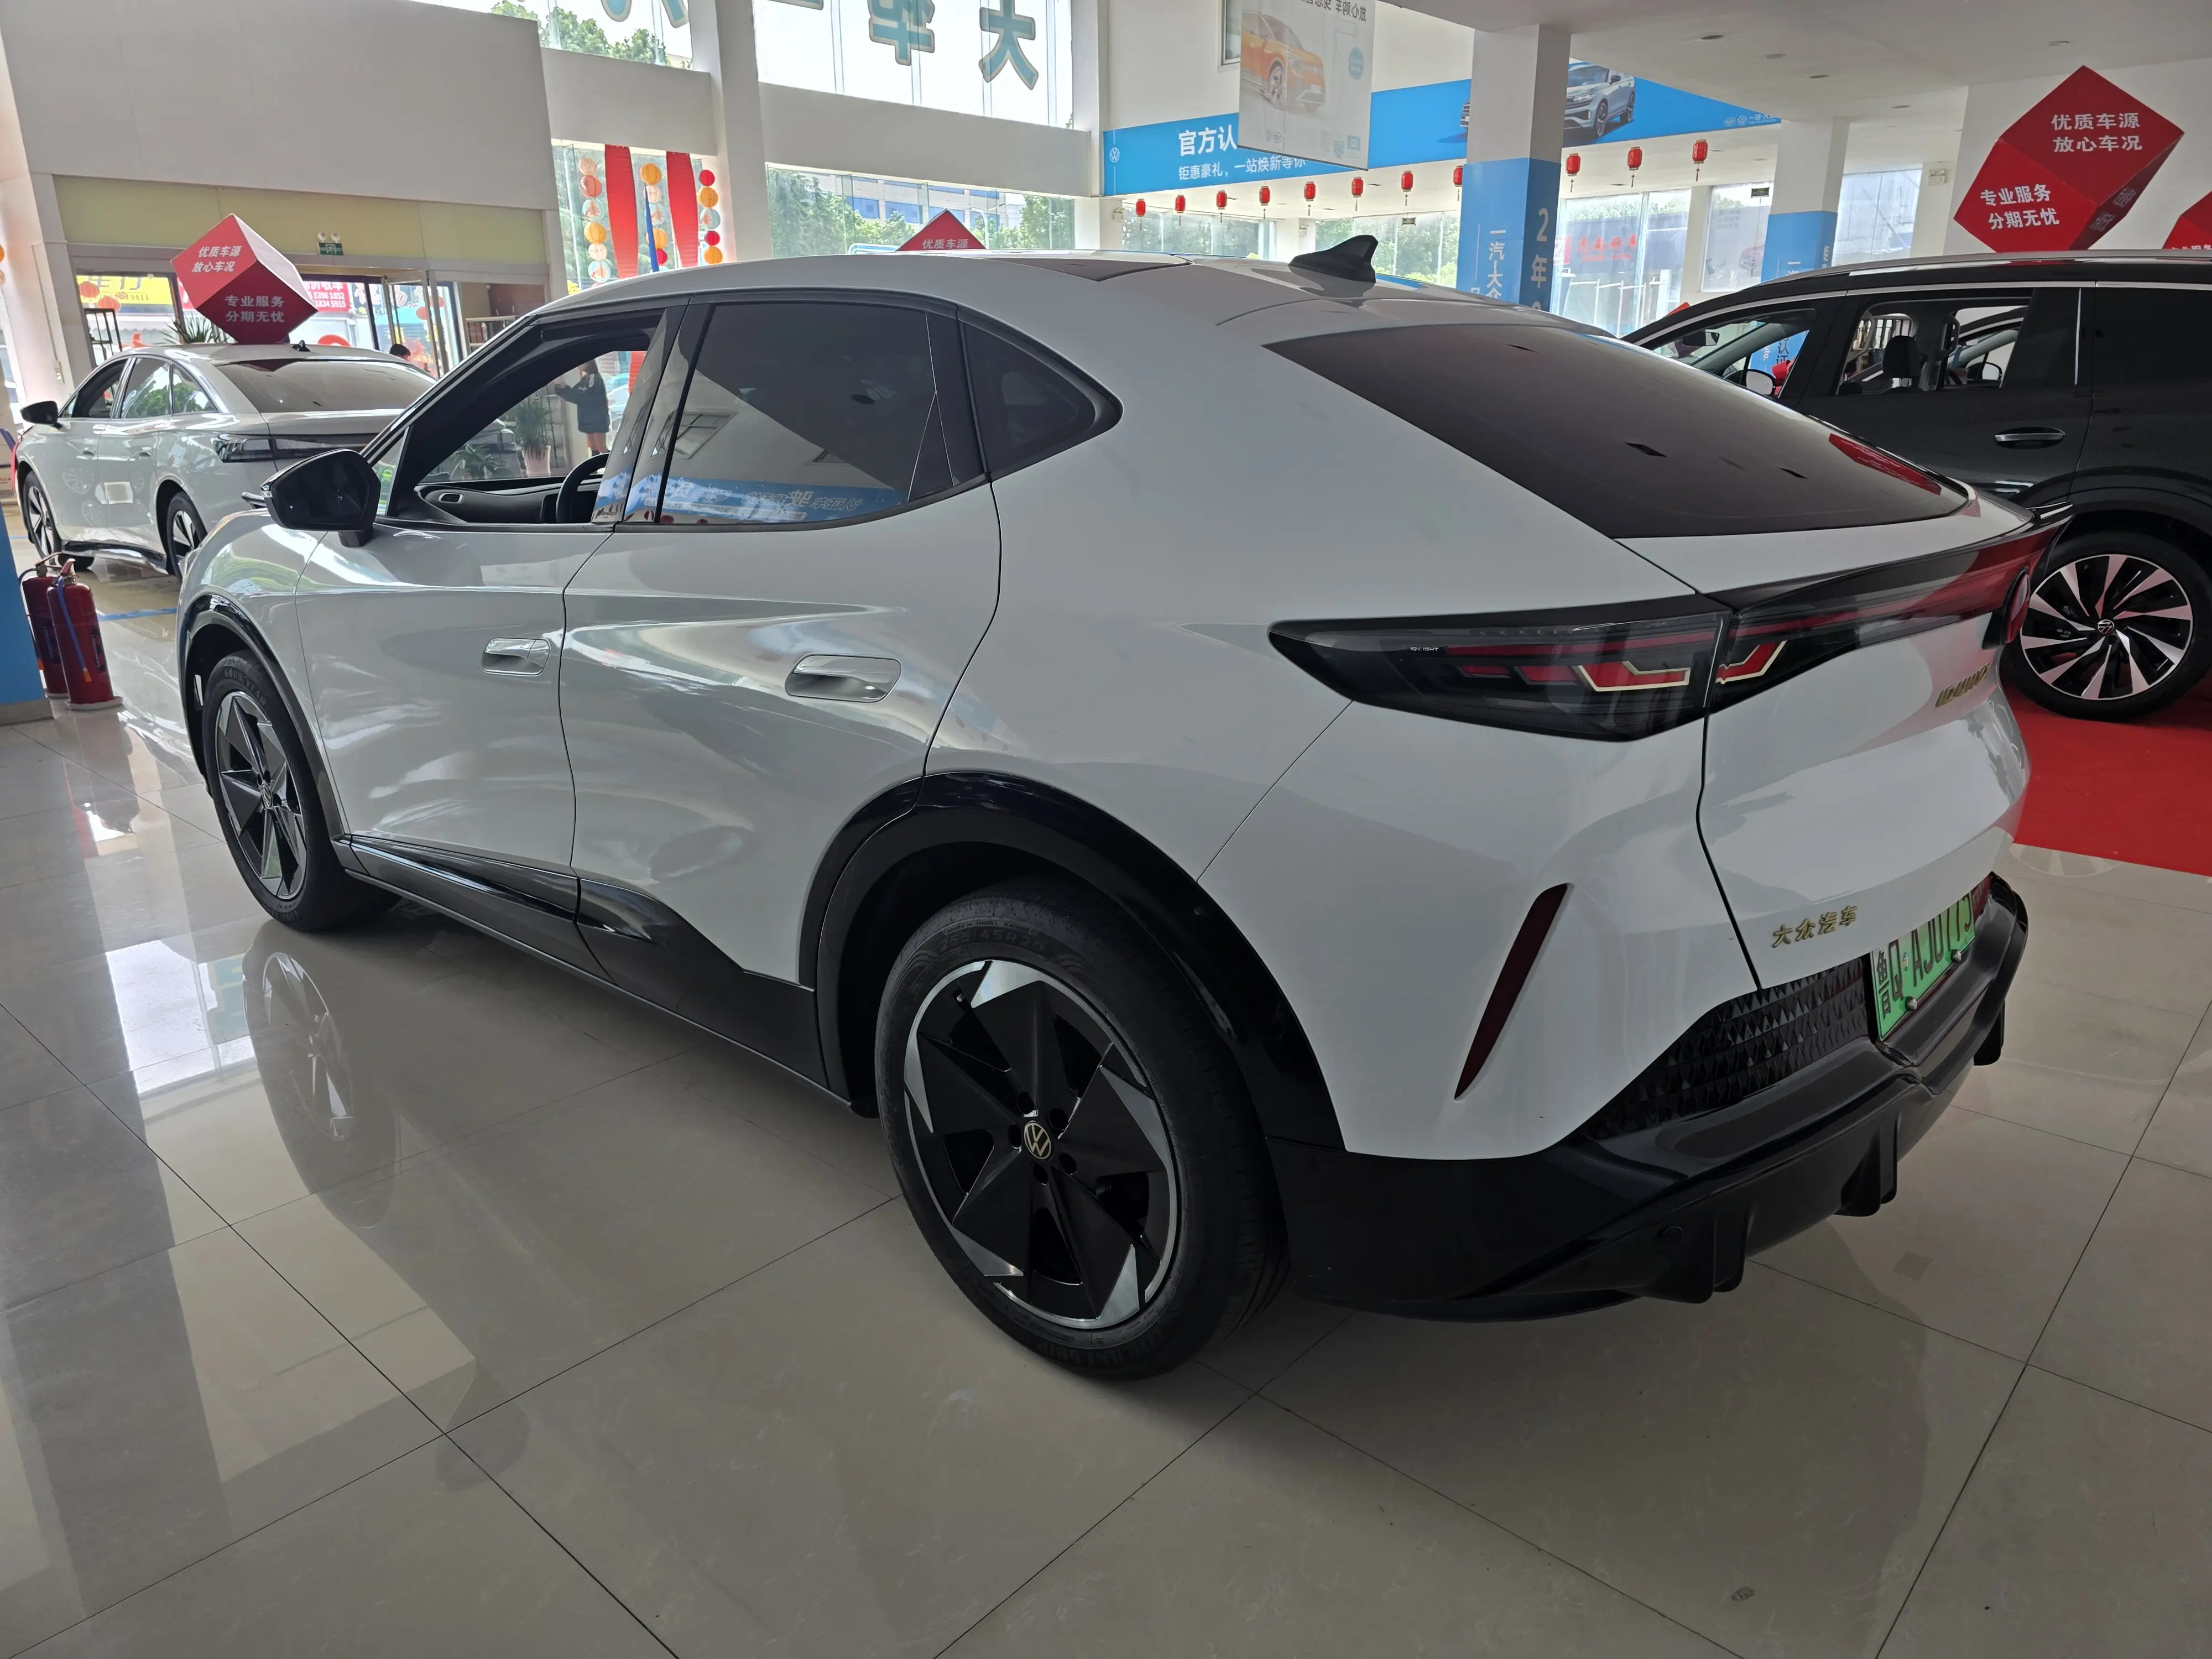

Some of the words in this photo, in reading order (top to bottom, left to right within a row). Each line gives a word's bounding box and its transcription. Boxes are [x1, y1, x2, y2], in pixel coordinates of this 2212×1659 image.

[2051, 112, 2140, 131] 优质车源
[1178, 124, 1237, 156] 官方认
[2053, 135, 2143, 153] 放心车况
[1980, 184, 2051, 206] 专业服务
[1988, 207, 2060, 230] 分期无忧
[198, 246, 242, 258] 优质车源
[922, 238, 969, 249] 优质车源
[191, 261, 235, 273] 放心车况
[1531, 207, 1548, 311] 2年
[225, 295, 285, 307] 专业服务
[226, 310, 285, 323] 分期无忧
[1772, 905, 1858, 948] 大众汽车
